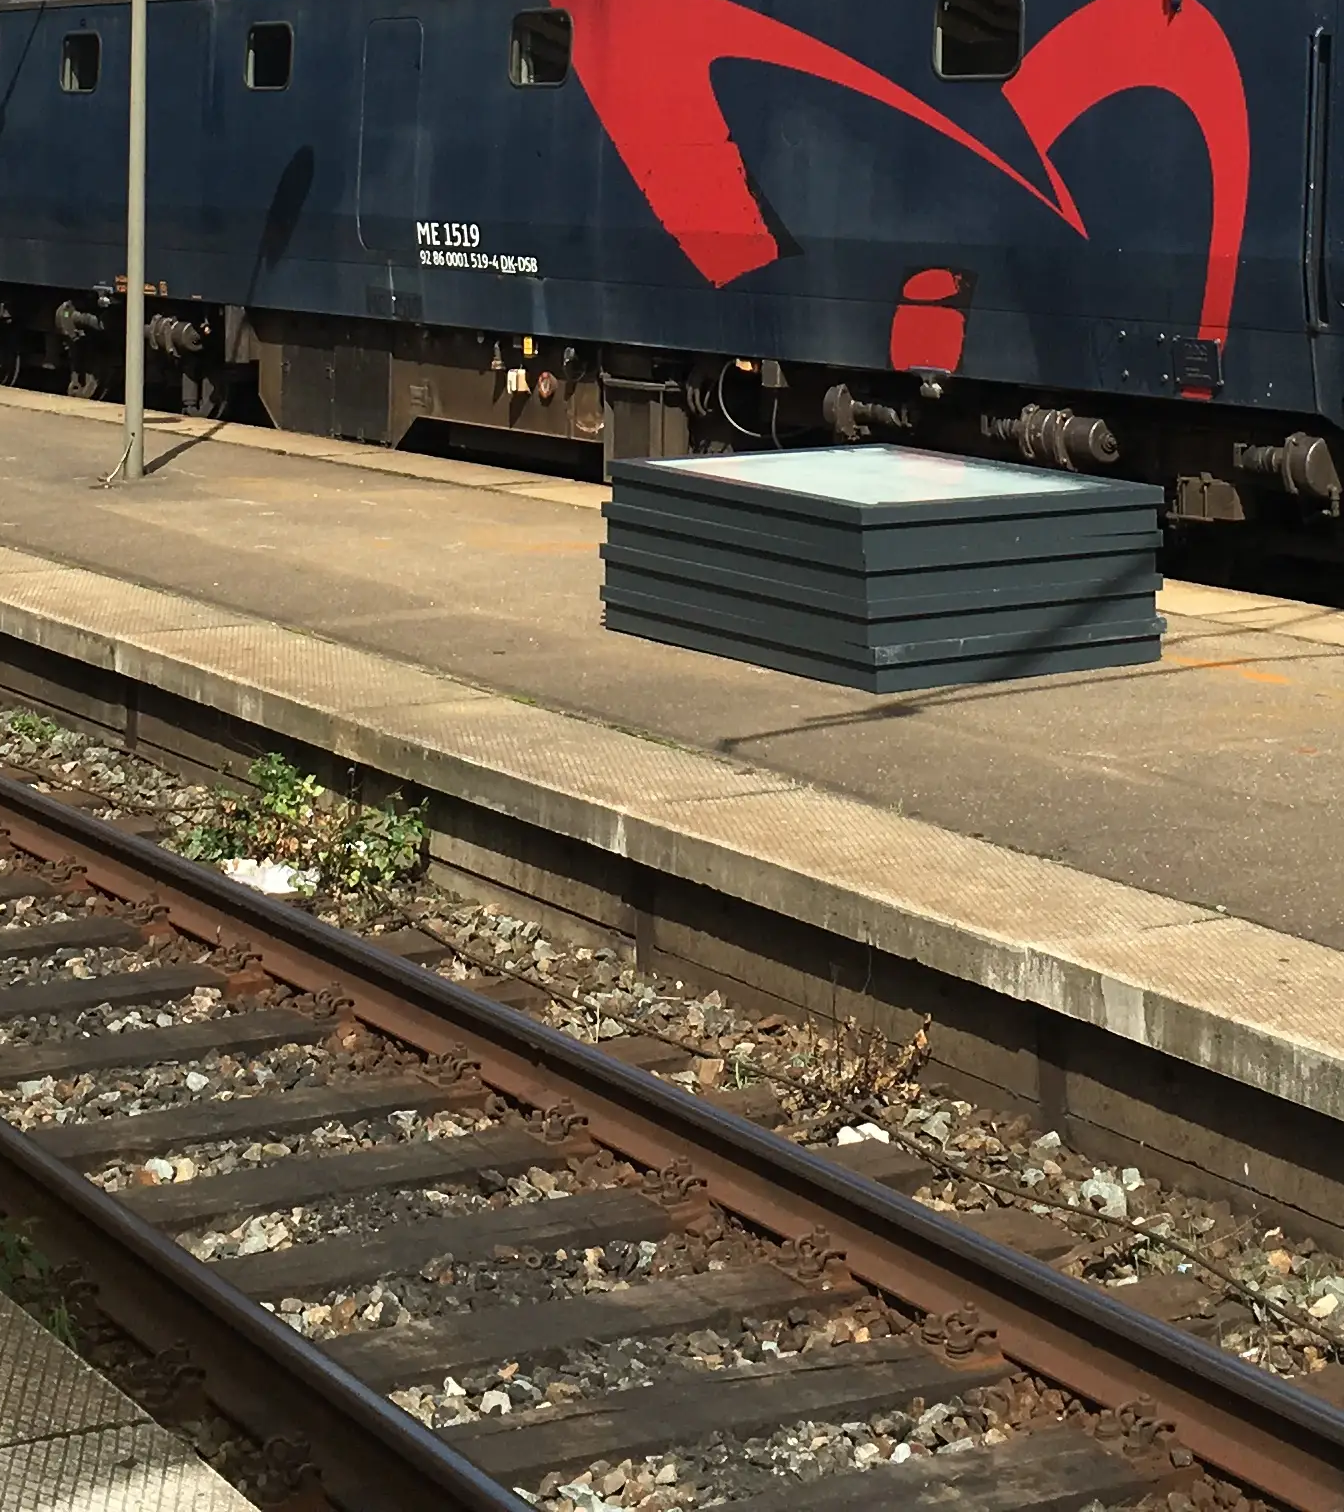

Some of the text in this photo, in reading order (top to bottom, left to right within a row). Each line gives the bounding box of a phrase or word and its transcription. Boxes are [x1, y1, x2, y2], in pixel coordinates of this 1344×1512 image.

[416, 221, 479, 247] ME 1519
[419, 249, 538, 273] 92 86 0001 519-4 DK-DSB
